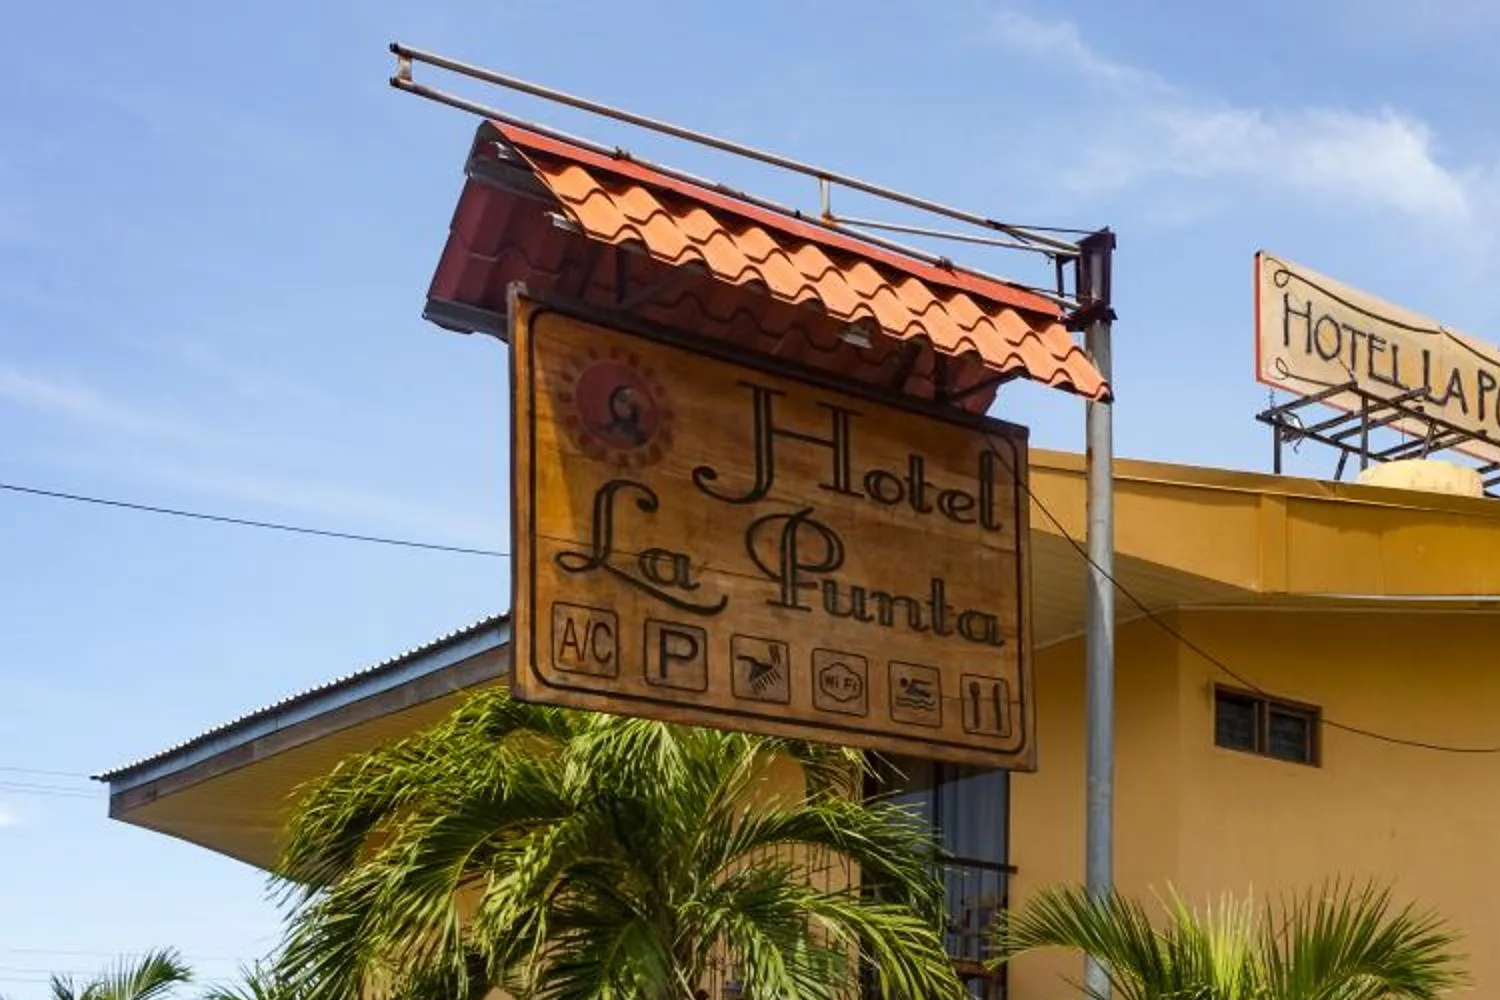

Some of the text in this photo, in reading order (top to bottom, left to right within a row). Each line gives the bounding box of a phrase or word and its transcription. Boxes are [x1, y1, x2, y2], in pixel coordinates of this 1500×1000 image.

[1282, 292, 1410, 391] HOTEL
[1422, 349, 1469, 416] LA
[691, 380, 1004, 533] Hotel
[554, 479, 1005, 648] La Punta
[558, 616, 612, 664] A/C
[659, 627, 699, 679] P
